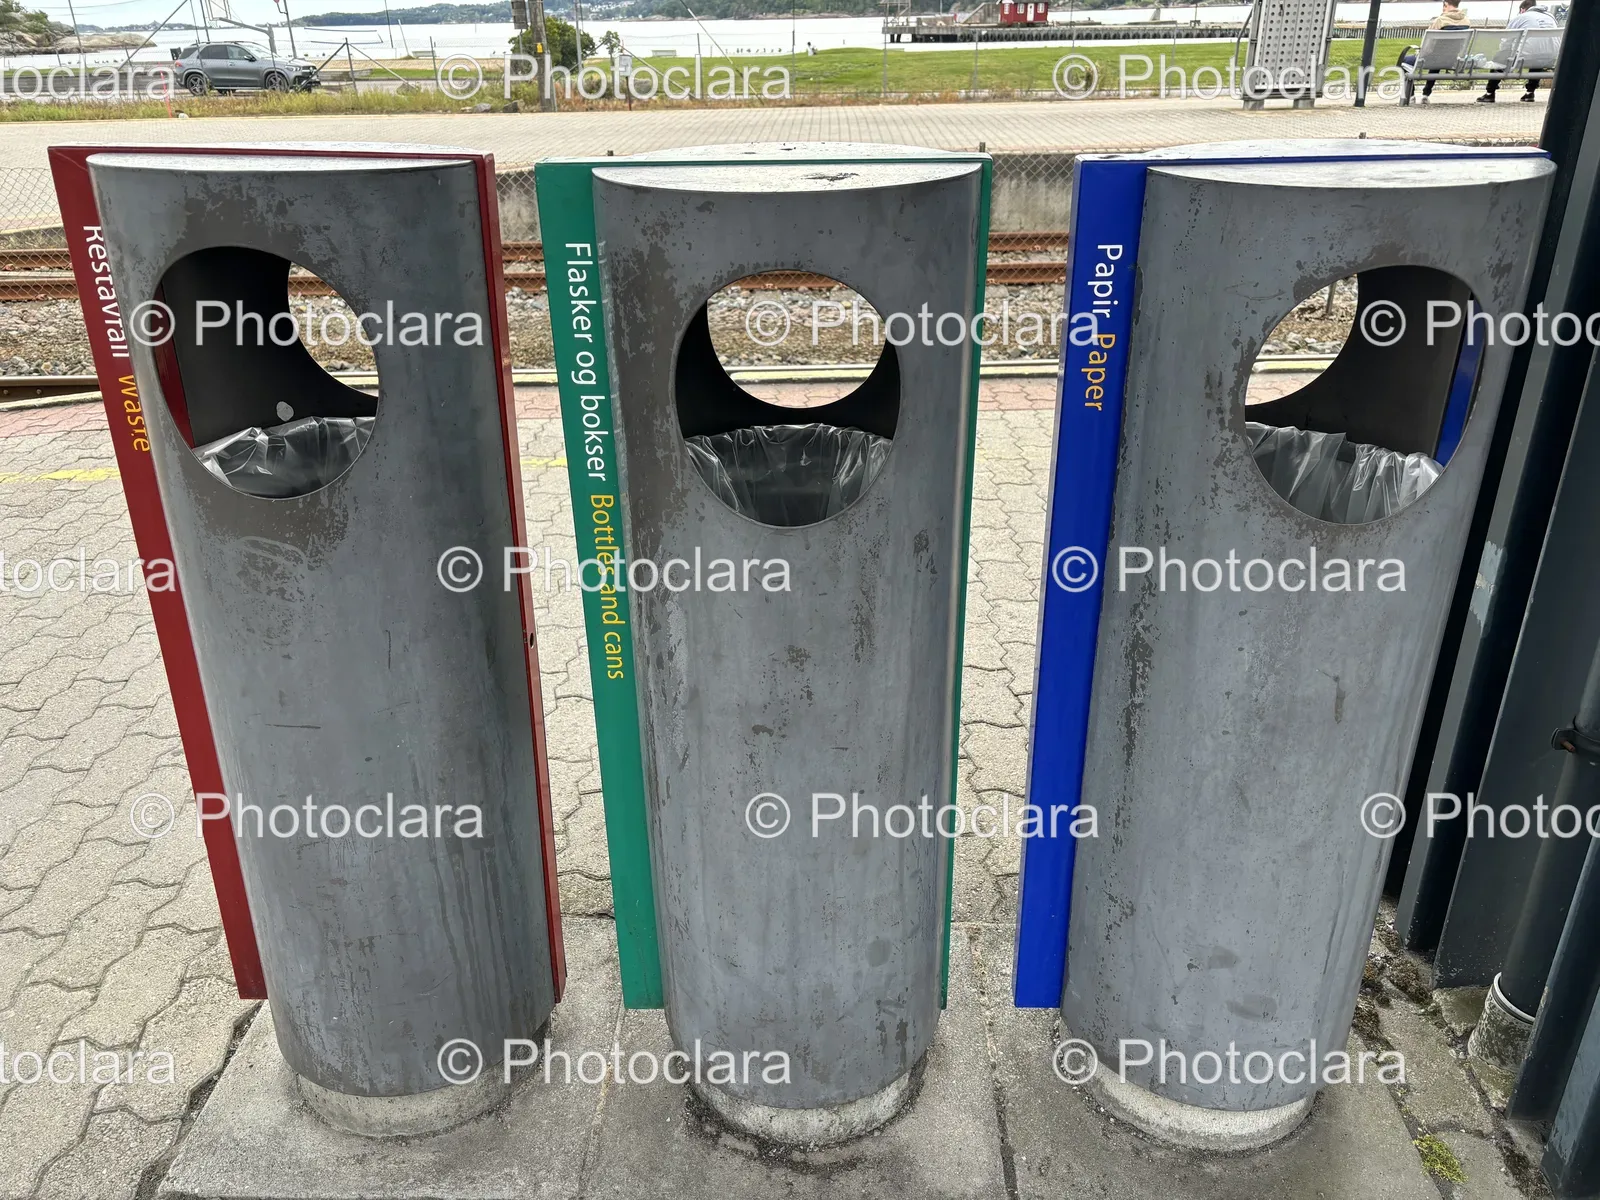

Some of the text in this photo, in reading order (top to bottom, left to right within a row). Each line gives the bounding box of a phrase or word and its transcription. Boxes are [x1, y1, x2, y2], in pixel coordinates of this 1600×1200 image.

[565, 243, 626, 680] Flasker og bokser Bottles and cans
[1081, 244, 1123, 411] Papir Paper
